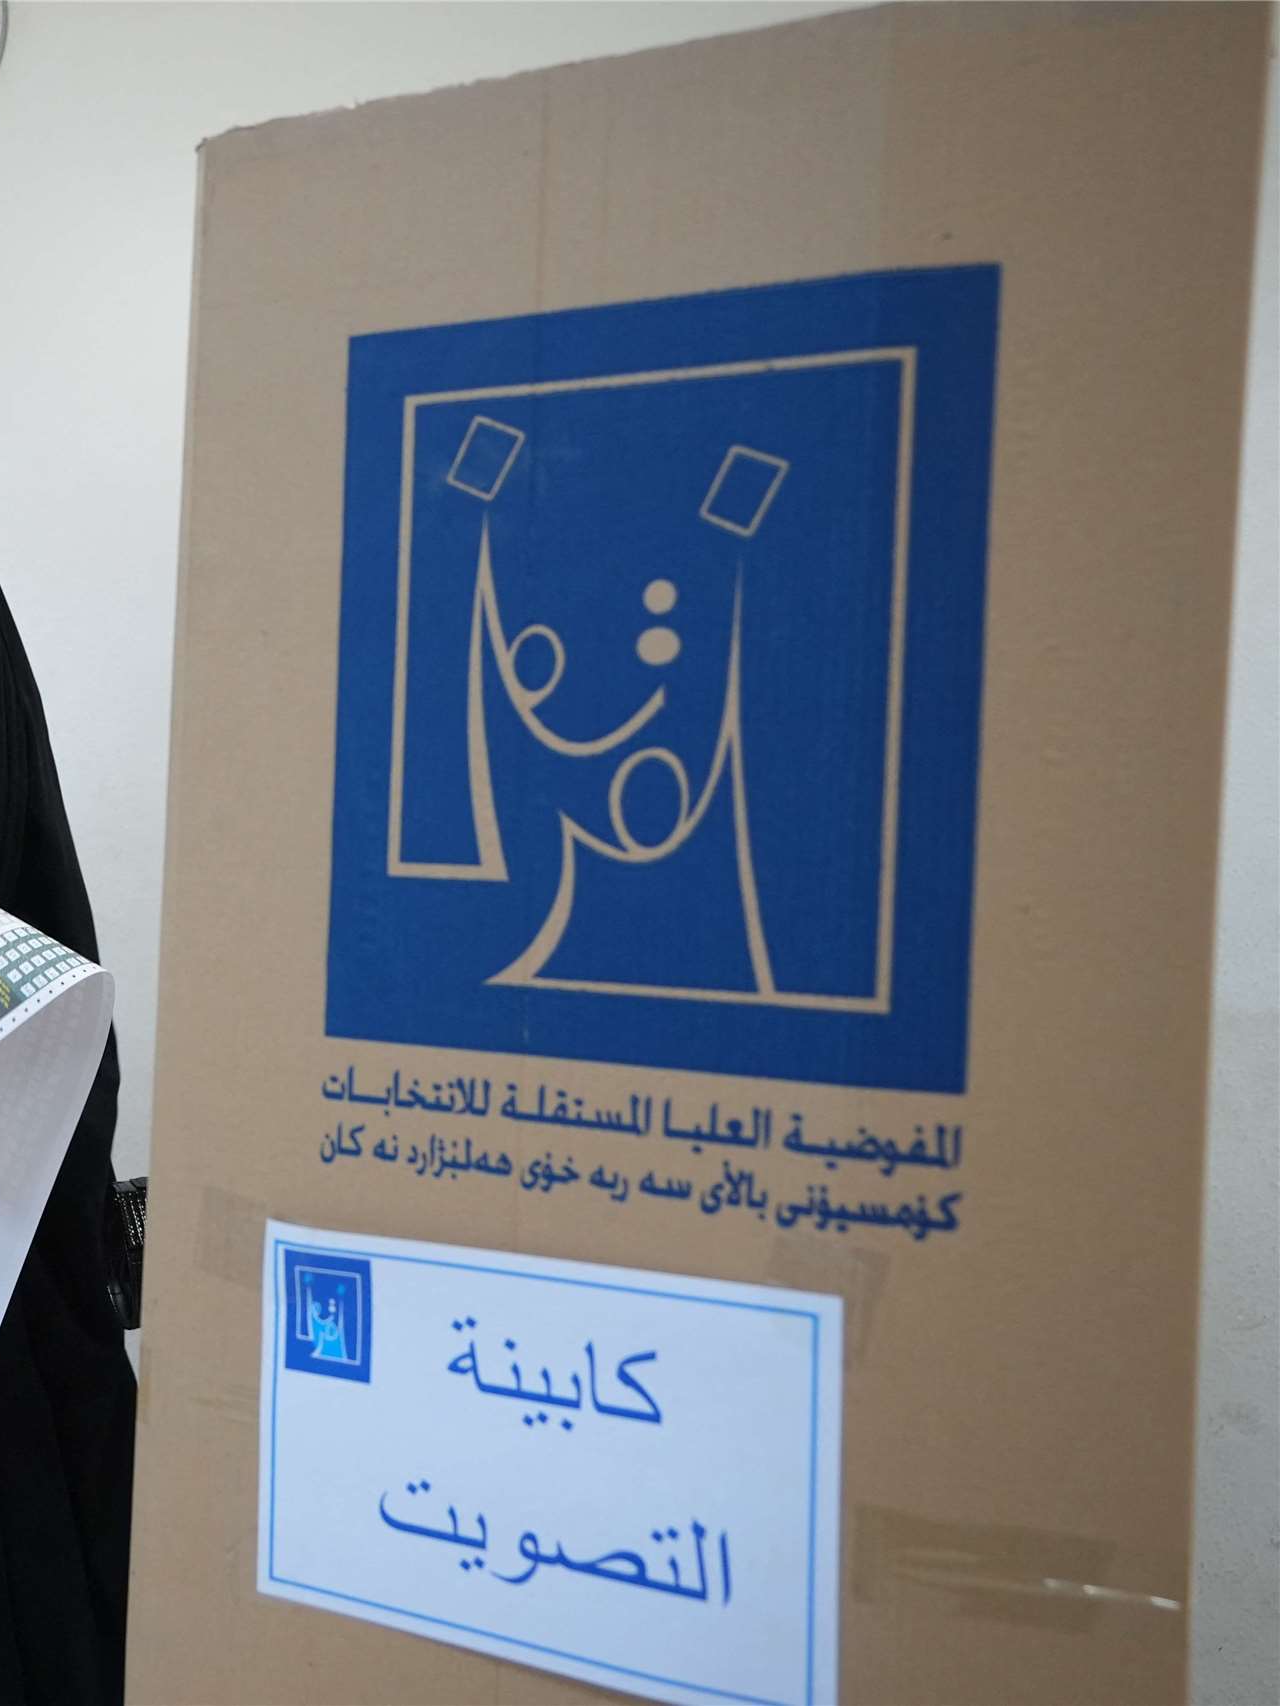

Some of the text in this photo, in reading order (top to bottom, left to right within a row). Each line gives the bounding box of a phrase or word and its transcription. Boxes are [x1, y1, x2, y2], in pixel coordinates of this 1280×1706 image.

[322, 1066, 962, 1177] المفوضية العليا المستقلة للانتخابات
[447, 1316, 662, 1431] كابينة
[379, 1478, 732, 1608] التصويت
